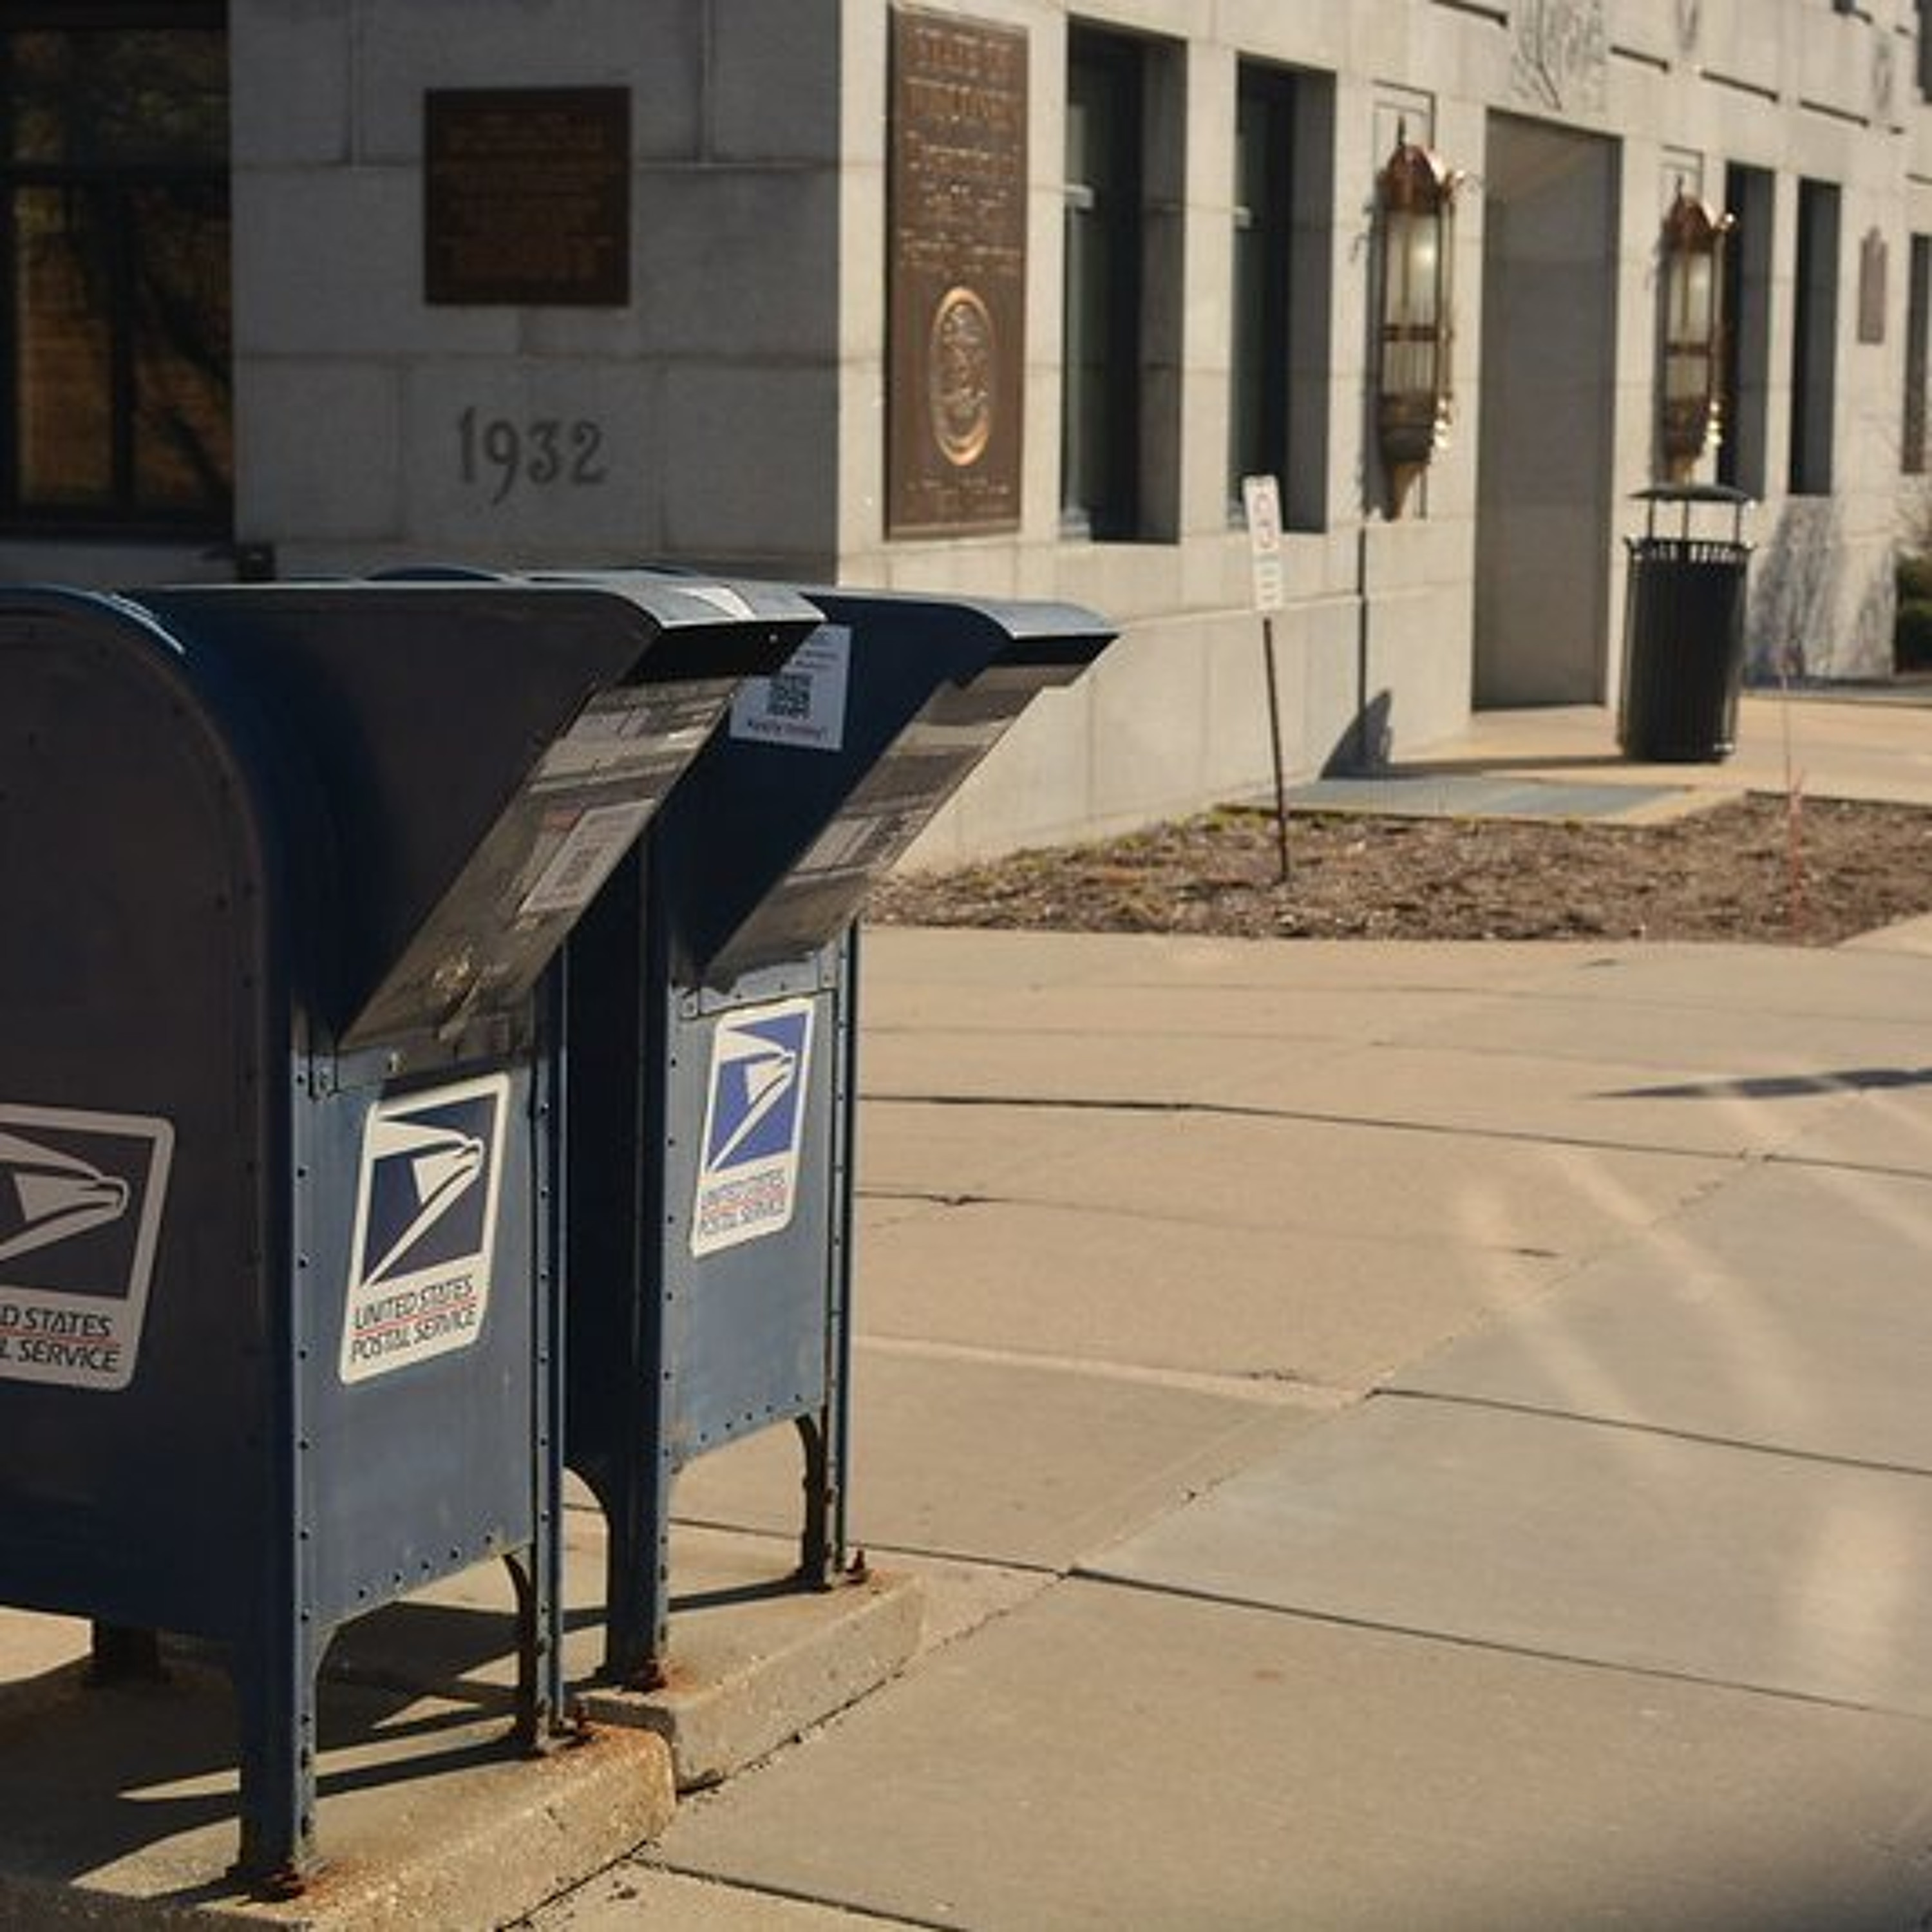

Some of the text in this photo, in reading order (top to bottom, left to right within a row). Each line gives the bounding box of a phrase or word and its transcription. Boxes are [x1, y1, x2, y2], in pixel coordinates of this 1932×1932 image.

[457, 406, 610, 506] 1932
[24, 1307, 113, 1338] STATES
[354, 1274, 474, 1329] UNITED STATES
[18, 1339, 120, 1373] SERVICE
[351, 1302, 477, 1363] POSTAL SERVICE
